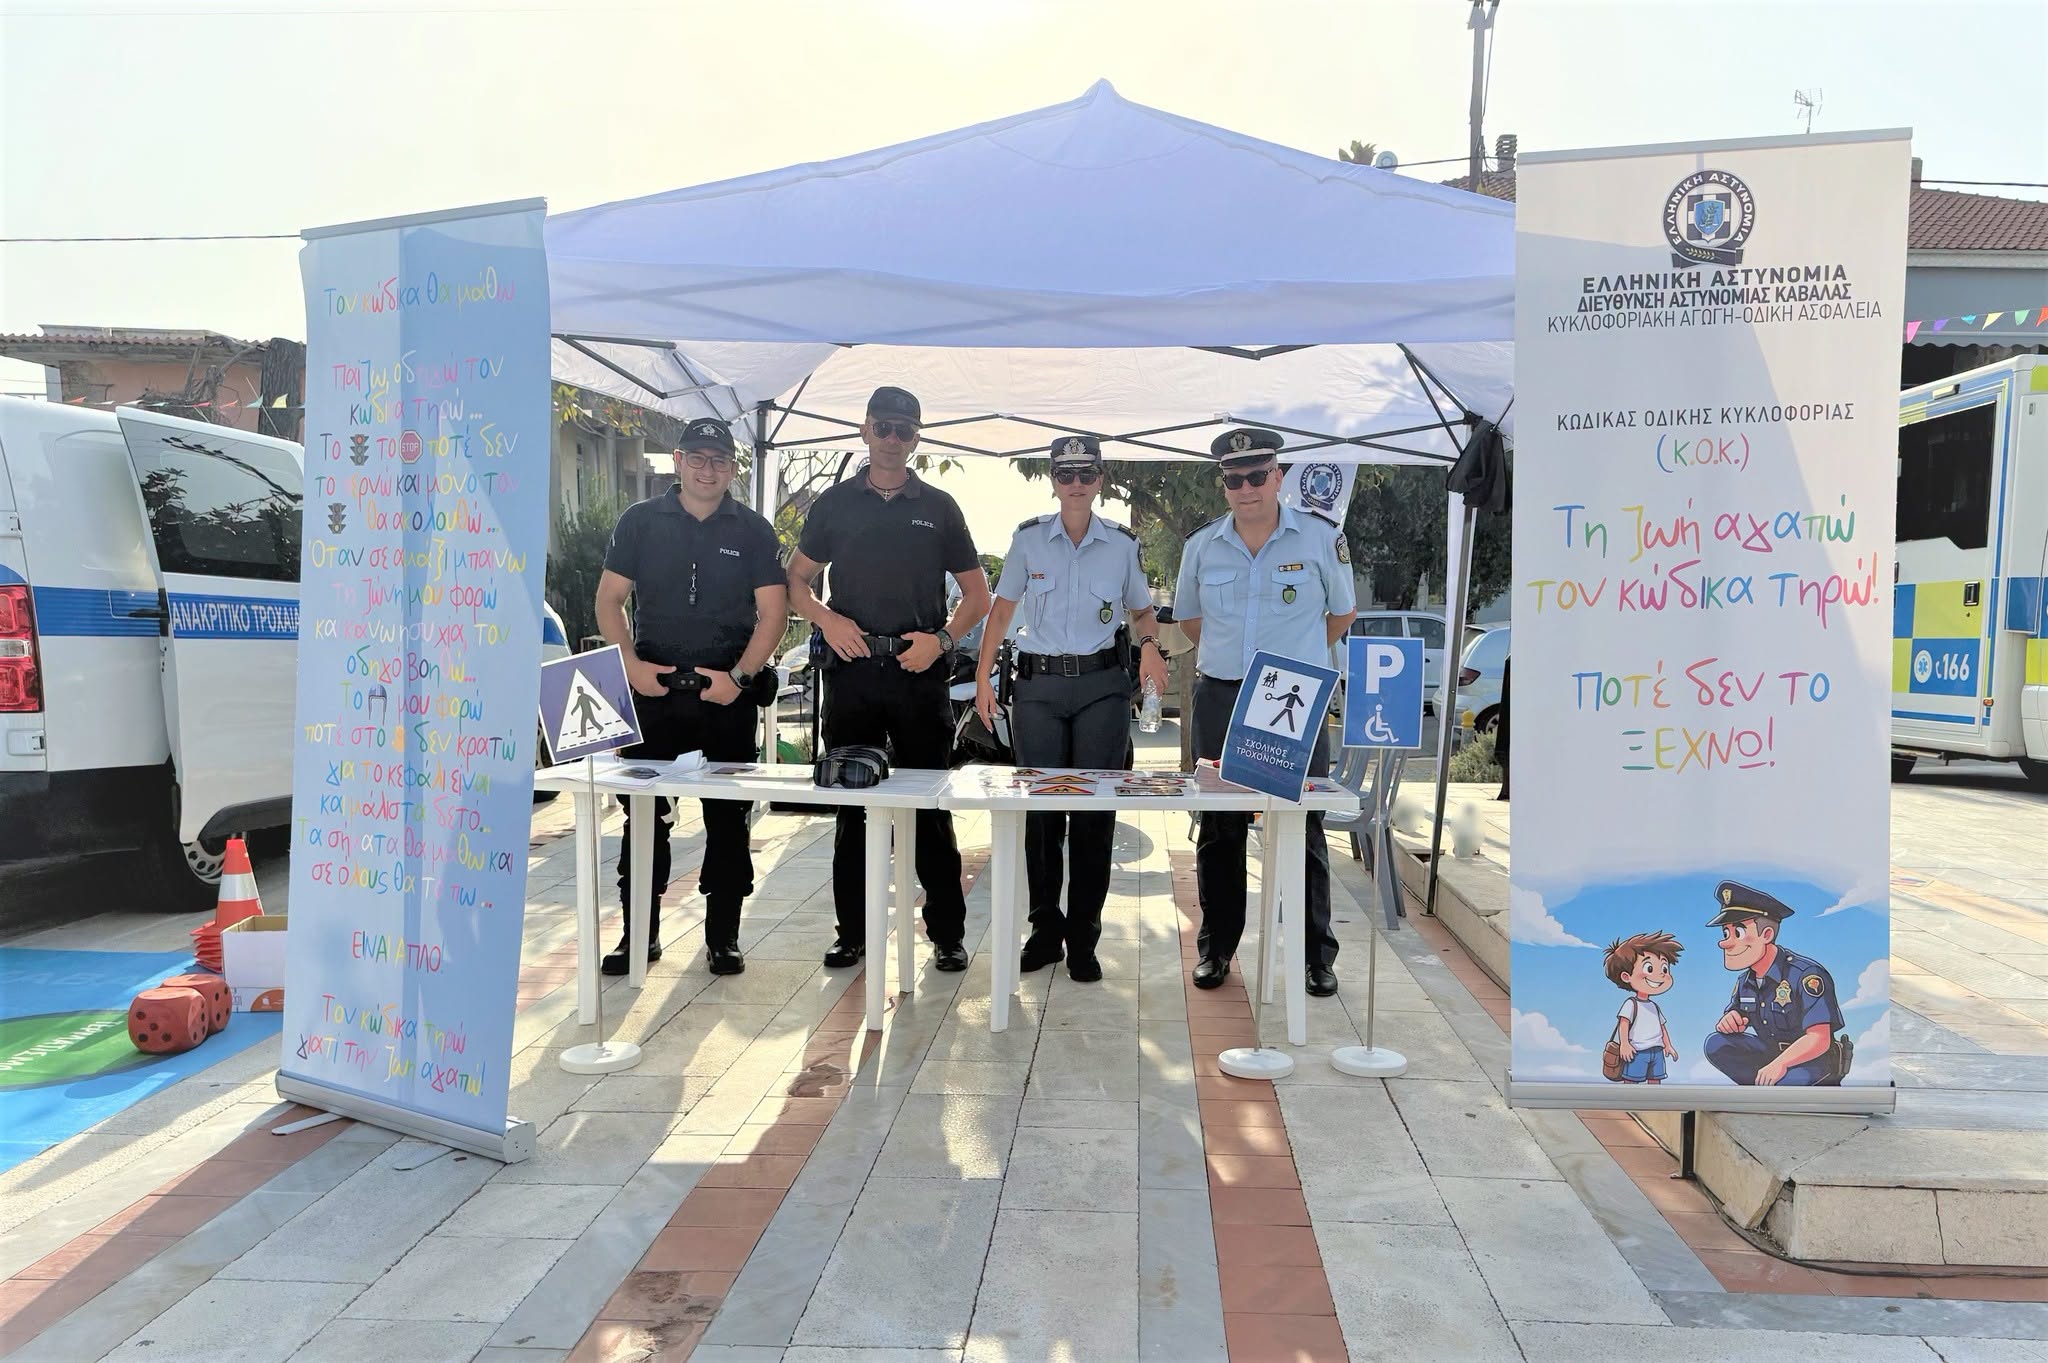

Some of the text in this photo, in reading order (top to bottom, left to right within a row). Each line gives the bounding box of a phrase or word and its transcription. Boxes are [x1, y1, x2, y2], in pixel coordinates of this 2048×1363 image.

[1666, 172, 1754, 246] ΕΛΛΗΝΙΚΗ ΑΣΤΥΝΟΜΙΑ
[324, 265, 515, 317] Τον κώδικα θα μάθω
[1577, 283, 1852, 313] ΔΙΕΥΘΥΝΣΗ ΑΣΤΥΝΟΜΙΑΣ ΚΑΒΑΛΑΣ
[1583, 264, 1847, 294] ΕΛΛΗΝΙΚΗ ΑΣΤΥΝΟΜΙΑ
[1547, 301, 1882, 333] ΚΥΚΛΟΦΟΡΙΑΚΗ ΑΓΩΓΗ-ΟΔΙΚΗ ΑΣΦΑΛΕΙΑ
[1557, 402, 1855, 432] ΚΩΔΙΚΑΣ ΟΔΙΚΗΣ ΚΥΚΛΟΦΟΡΙΑΣ
[401, 440, 419, 453] STOP
[427, 425, 472, 459] ποτέ
[480, 422, 519, 458] δεν
[1656, 431, 1750, 474] (Κ.Ο.Κ.)
[396, 473, 421, 498] και
[1301, 463, 1320, 495] ΕΛΛΗΝΙΚ
[366, 497, 388, 532] θα
[911, 519, 935, 529] POLICE
[1553, 494, 1856, 563] Τη ζωή αγαπώ
[369, 544, 388, 570] σε
[409, 583, 443, 616] μου
[450, 578, 497, 623] φορώ
[1618, 559, 1754, 613] κώδικα
[1768, 551, 1880, 630] τηρώ!
[172, 600, 250, 632] ΑΝΑΚΡΙΤΙΚΟ
[346, 644, 402, 684] οδηγό
[1684, 657, 1766, 709] δεν
[1942, 652, 1970, 682] 166
[397, 694, 430, 724] μου
[434, 689, 483, 735] φορώ
[351, 725, 386, 748] στο
[414, 720, 452, 752] δεν
[456, 729, 516, 770] κρατώ
[1236, 746, 1296, 771] ΤΡΟΧΟΝΟΜΟΣ
[1245, 738, 1289, 758] ΣΧΟΛΙΚΟΣ
[325, 759, 355, 787] για
[387, 758, 446, 792] κεφάλι
[451, 764, 491, 796] είναι
[404, 826, 426, 858] θα
[489, 850, 514, 876] και
[311, 861, 332, 885] σε
[338, 856, 388, 894] όλους
[393, 861, 415, 894] θα
[351, 928, 446, 974] ΕΙΝΑΙ ΑΠΛΟ!
[322, 992, 357, 1025] Τον
[360, 1000, 417, 1040] κώδικα
